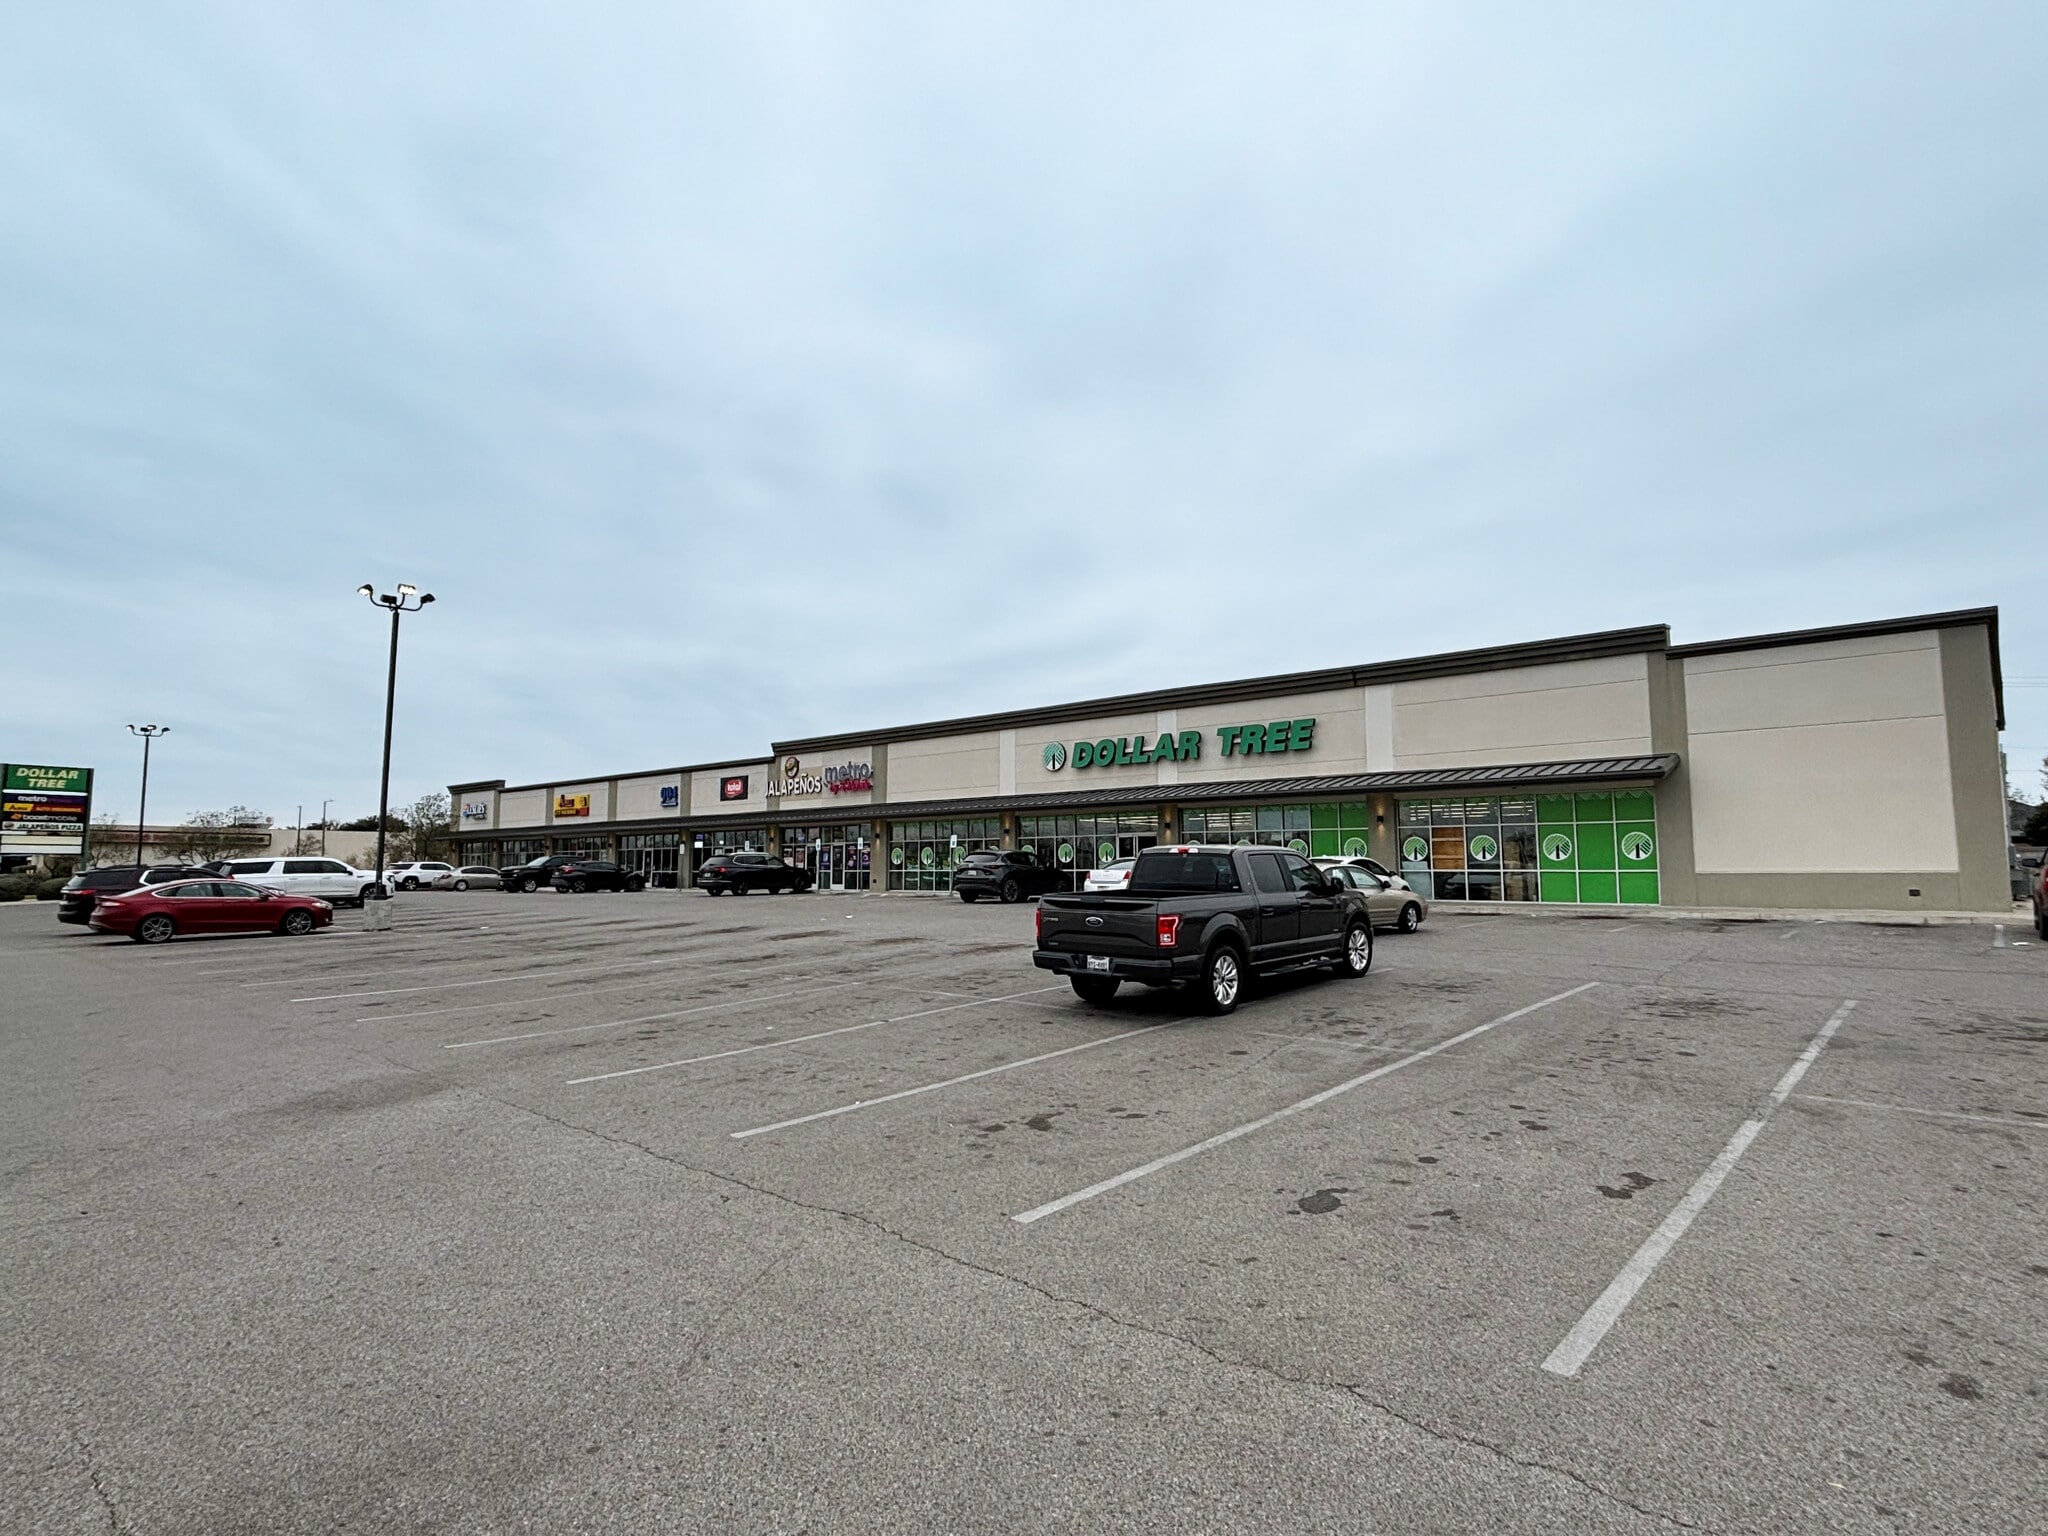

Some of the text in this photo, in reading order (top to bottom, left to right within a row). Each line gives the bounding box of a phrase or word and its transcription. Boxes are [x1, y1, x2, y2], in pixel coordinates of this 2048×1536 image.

[1072, 718, 1316, 769] DOLLAR TREE
[16, 768, 79, 779] DOLLAR
[824, 761, 871, 781] metro
[28, 778, 67, 788] TREE
[765, 773, 822, 797] JALAPEÑOS
